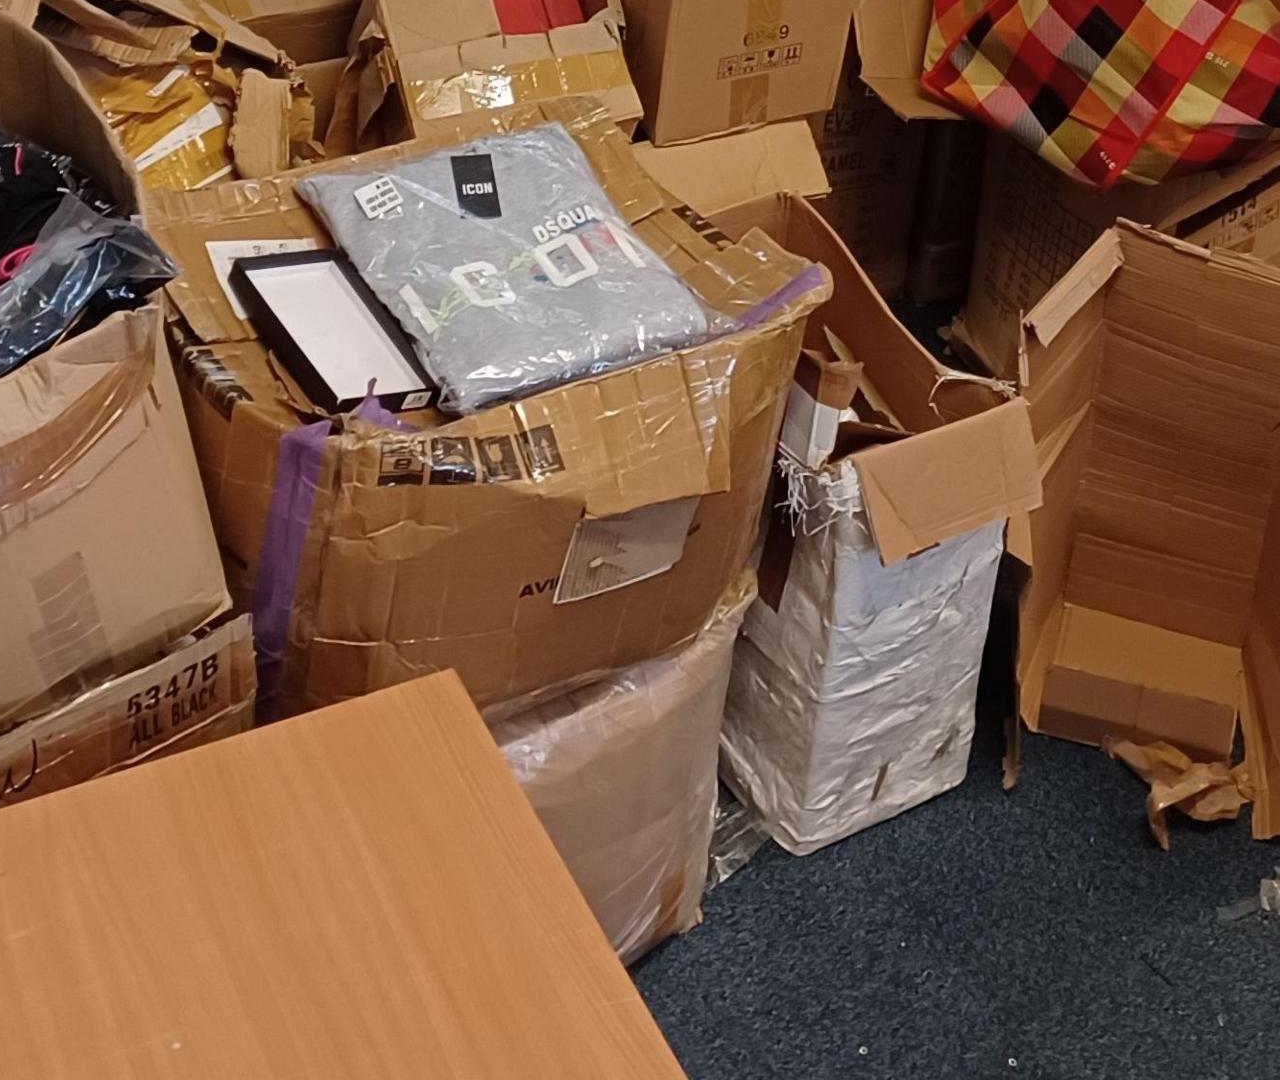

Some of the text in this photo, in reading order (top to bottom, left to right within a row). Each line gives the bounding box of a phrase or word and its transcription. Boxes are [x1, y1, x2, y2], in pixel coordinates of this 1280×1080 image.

[461, 181, 495, 196] ICON
[127, 653, 219, 719] 5347B
[128, 681, 217, 751] ALL BLACK
